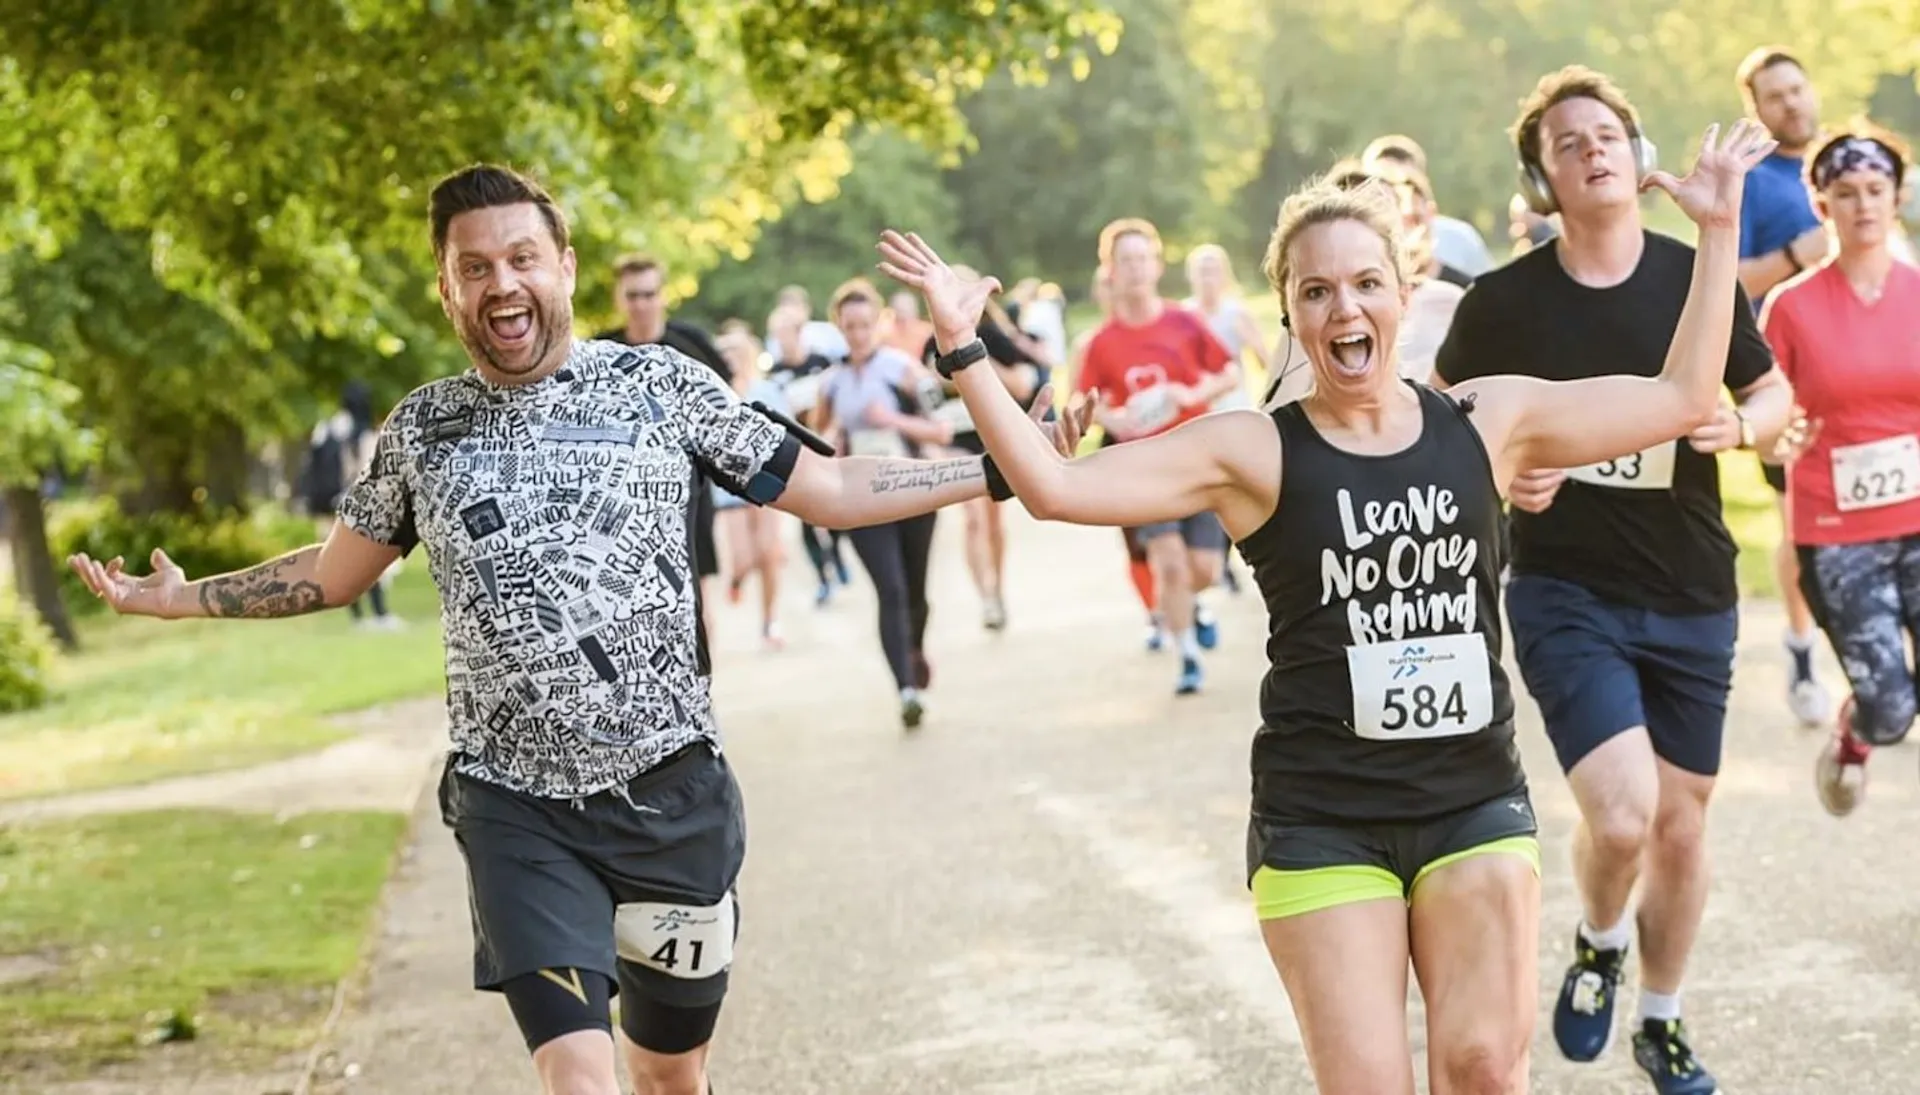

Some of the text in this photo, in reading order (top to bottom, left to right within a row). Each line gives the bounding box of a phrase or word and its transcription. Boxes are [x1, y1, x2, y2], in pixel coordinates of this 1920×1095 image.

[1851, 468, 1907, 501] 622
[1321, 548, 1381, 606] No
[1381, 681, 1468, 731] 584
[650, 938, 703, 970] 41
